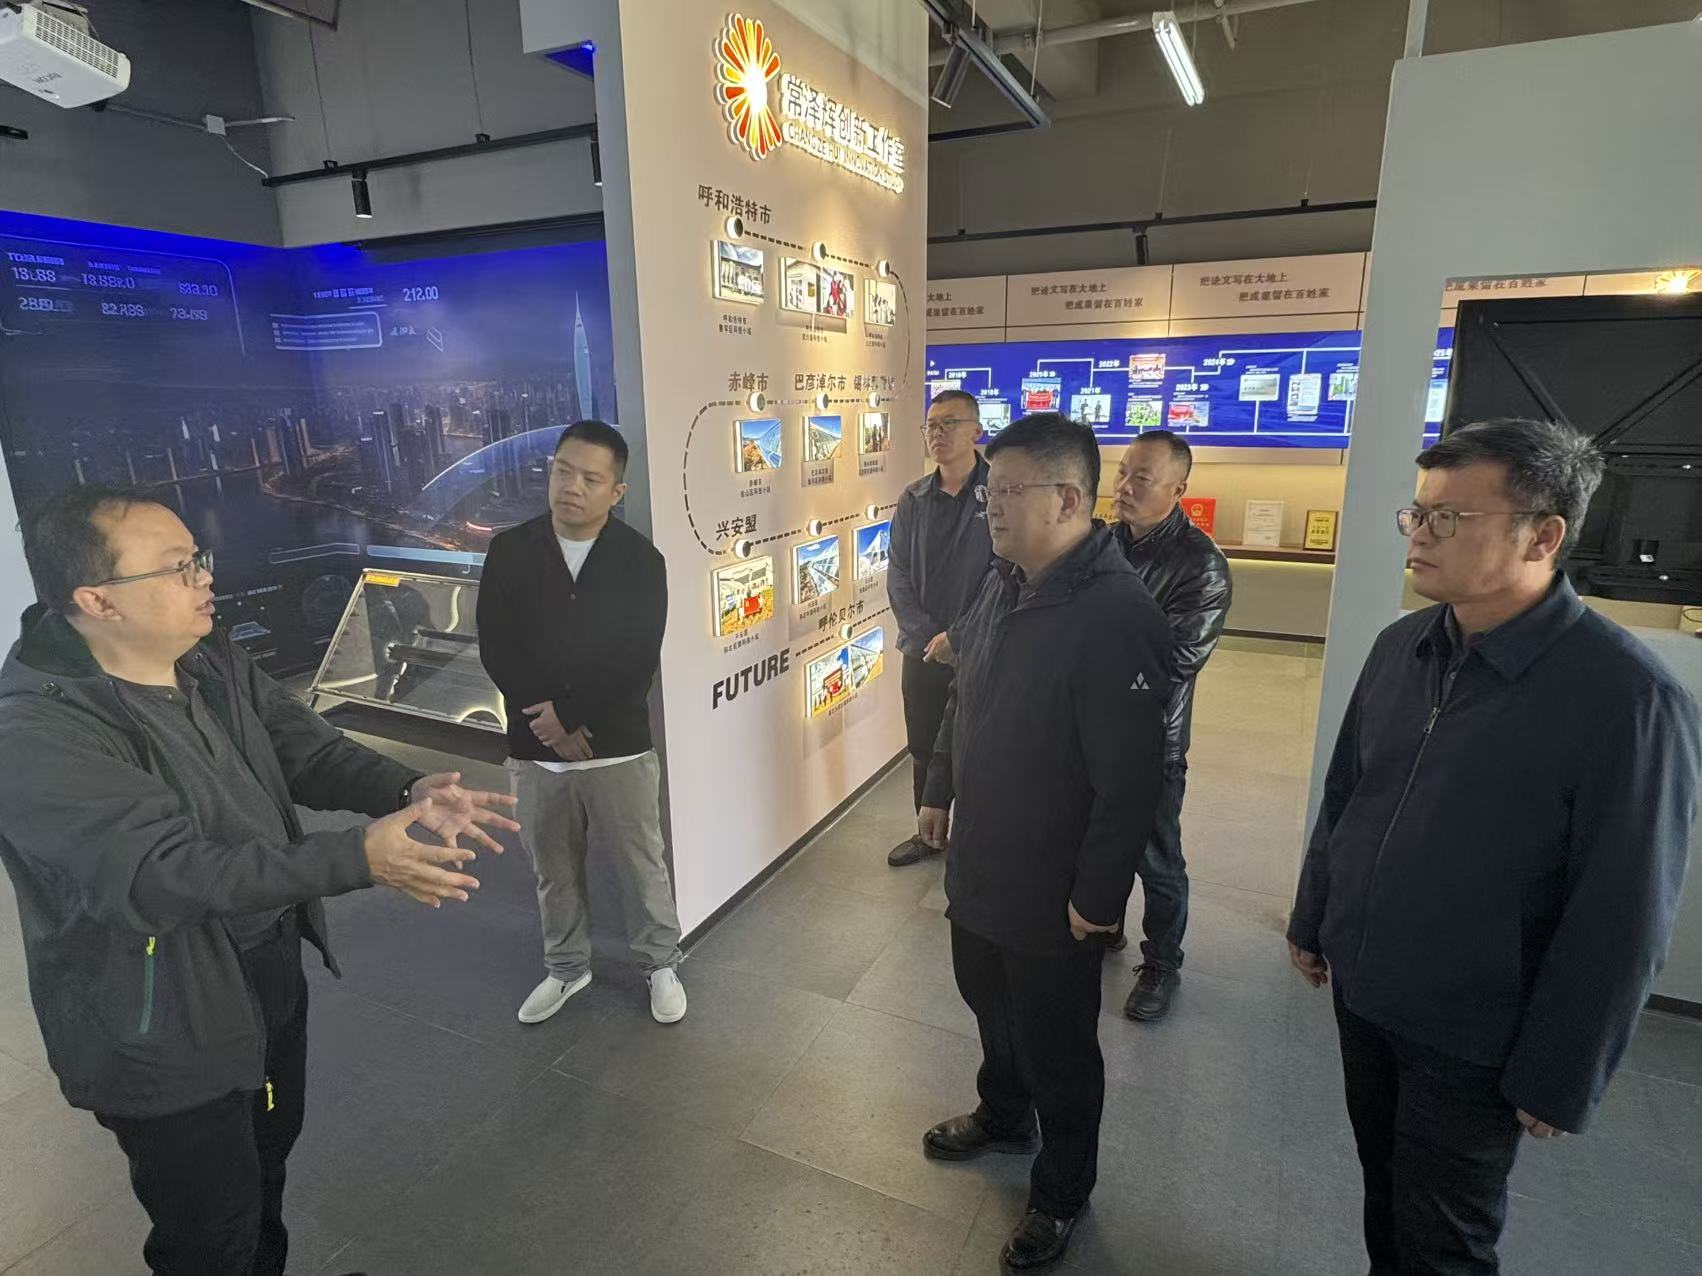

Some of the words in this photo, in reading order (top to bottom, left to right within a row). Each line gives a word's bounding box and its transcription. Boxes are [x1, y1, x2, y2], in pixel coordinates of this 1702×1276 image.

[787, 76, 904, 171] 常泽辉创新工作室
[698, 184, 772, 225] 呼和浩特市
[1200, 272, 1288, 286] 把论文写在大地上
[403, 286, 439, 302] 212.00
[927, 292, 952, 302] 大地上
[1031, 283, 1107, 296] 把论文写在大地上
[1238, 288, 1331, 302] 把成果留在百姓家
[1065, 297, 1143, 310] 把成果留在百姓家
[1098, 360, 1120, 368] 2022年
[728, 371, 769, 393] 赤峰市
[794, 373, 847, 392] 巴彦淖尔市
[716, 514, 757, 541] 兴安盟
[818, 599, 864, 632] 呼伦贝尔市
[712, 648, 790, 710] FUTURE
